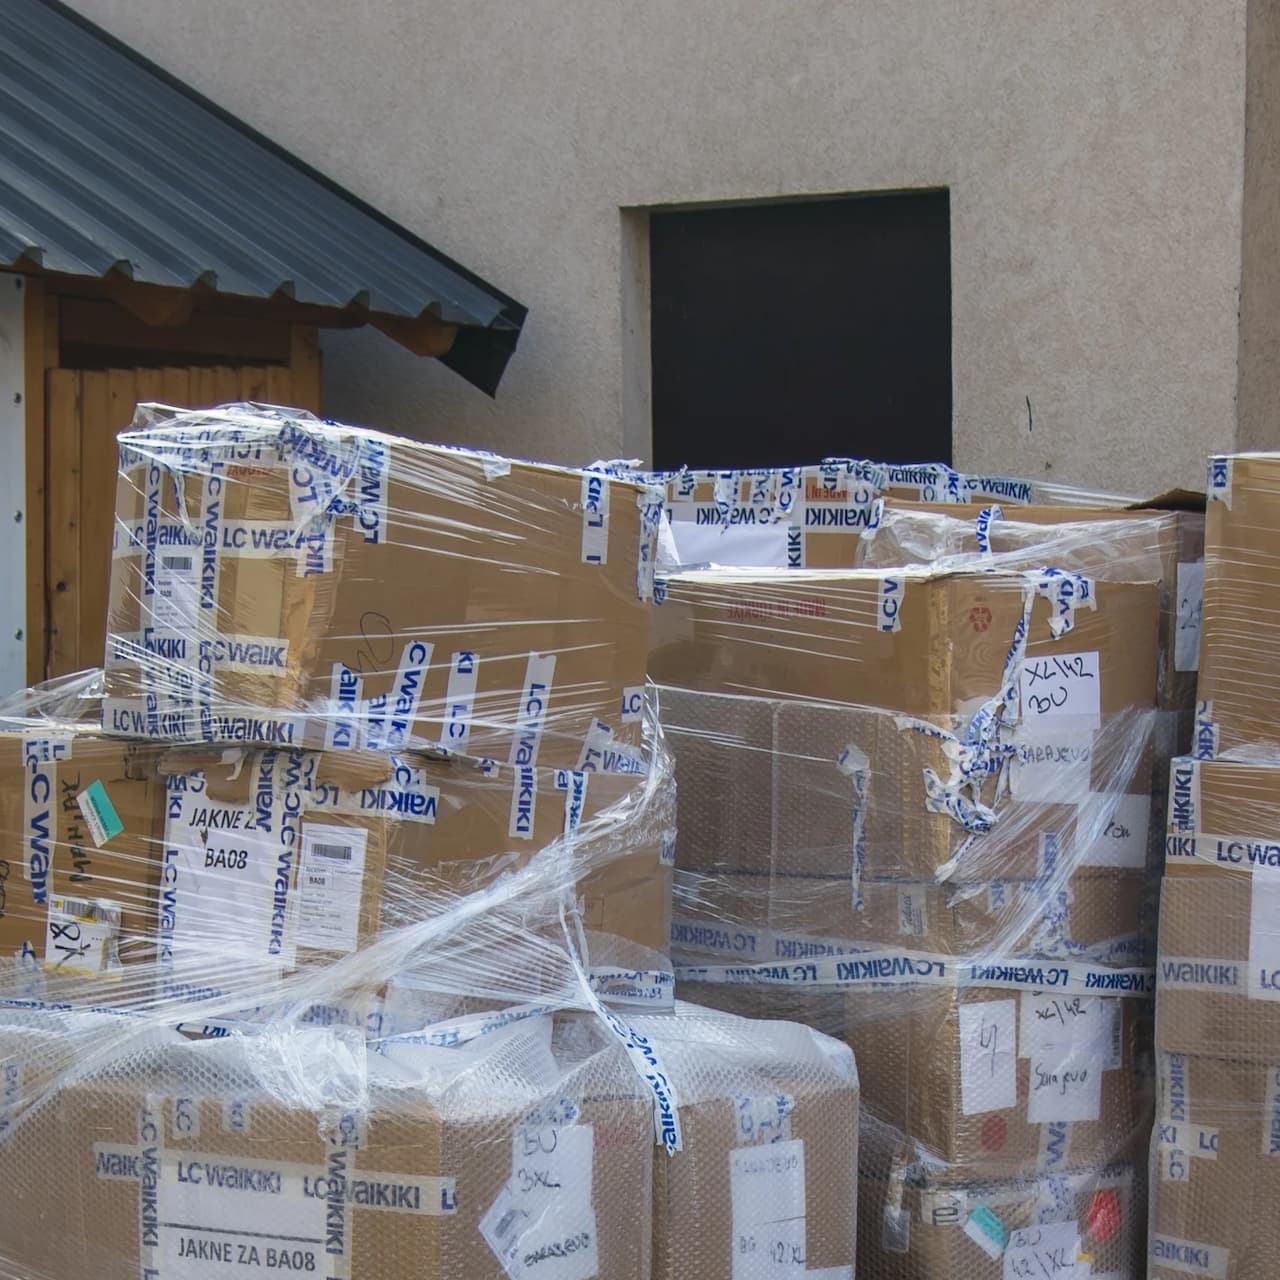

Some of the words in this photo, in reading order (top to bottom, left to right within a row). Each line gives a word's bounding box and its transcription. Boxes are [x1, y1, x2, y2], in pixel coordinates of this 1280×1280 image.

[223, 527, 247, 549] LC
[525, 683, 547, 718] LC
[622, 693, 641, 714] LC
[113, 710, 130, 732] LC
[189, 808, 241, 829] JAKNE
[205, 848, 248, 869] BA08
[1217, 841, 1243, 863] LC
[916, 960, 945, 978] LC
[1045, 968, 1068, 986] LC
[178, 1160, 202, 1184] LC
[178, 1237, 232, 1263] JAKNE
[237, 1243, 261, 1267] ZA
[266, 1248, 316, 1272] BA08
